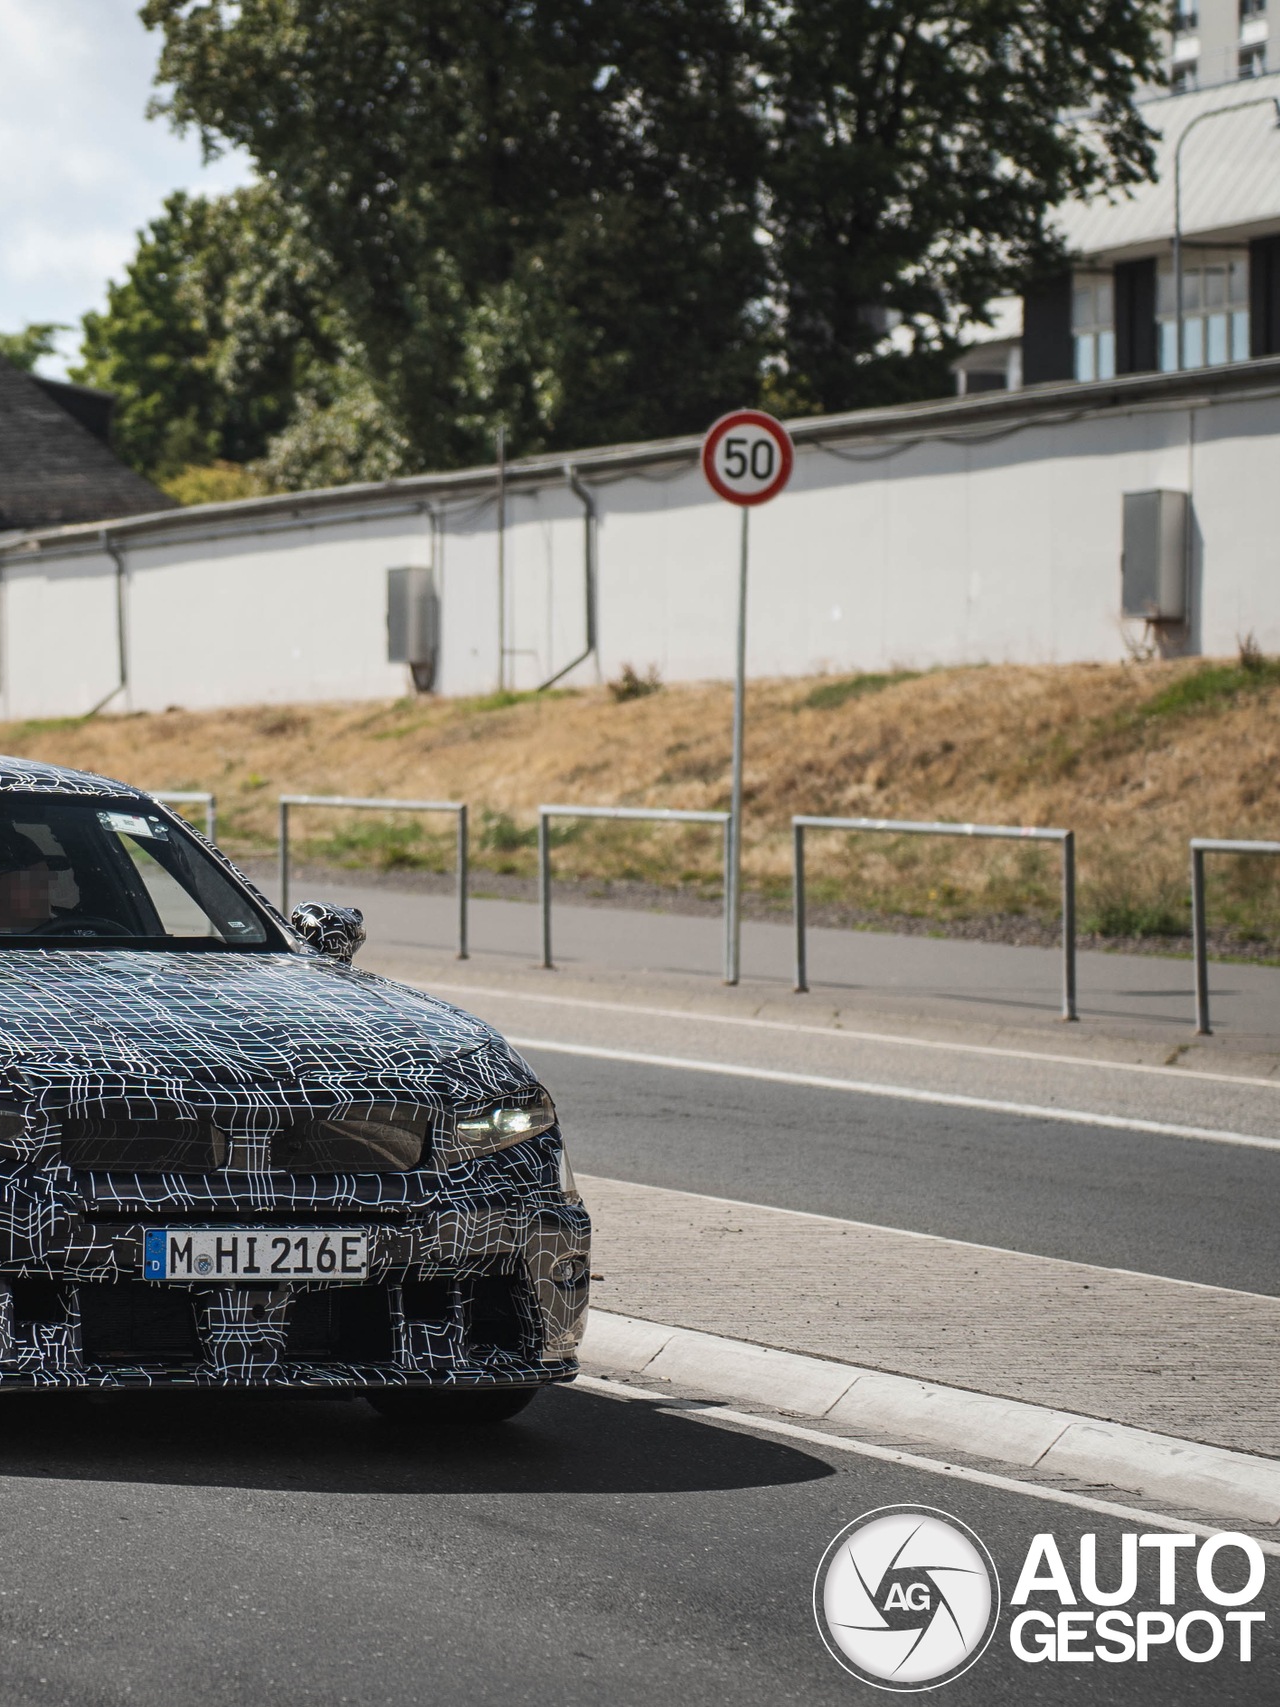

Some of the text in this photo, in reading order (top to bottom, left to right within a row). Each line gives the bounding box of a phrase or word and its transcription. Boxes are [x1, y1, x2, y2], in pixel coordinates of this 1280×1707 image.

[724, 437, 774, 481] 50
[151, 1260, 161, 1271] D
[170, 1237, 192, 1273] M
[271, 1237, 361, 1273] 216E
